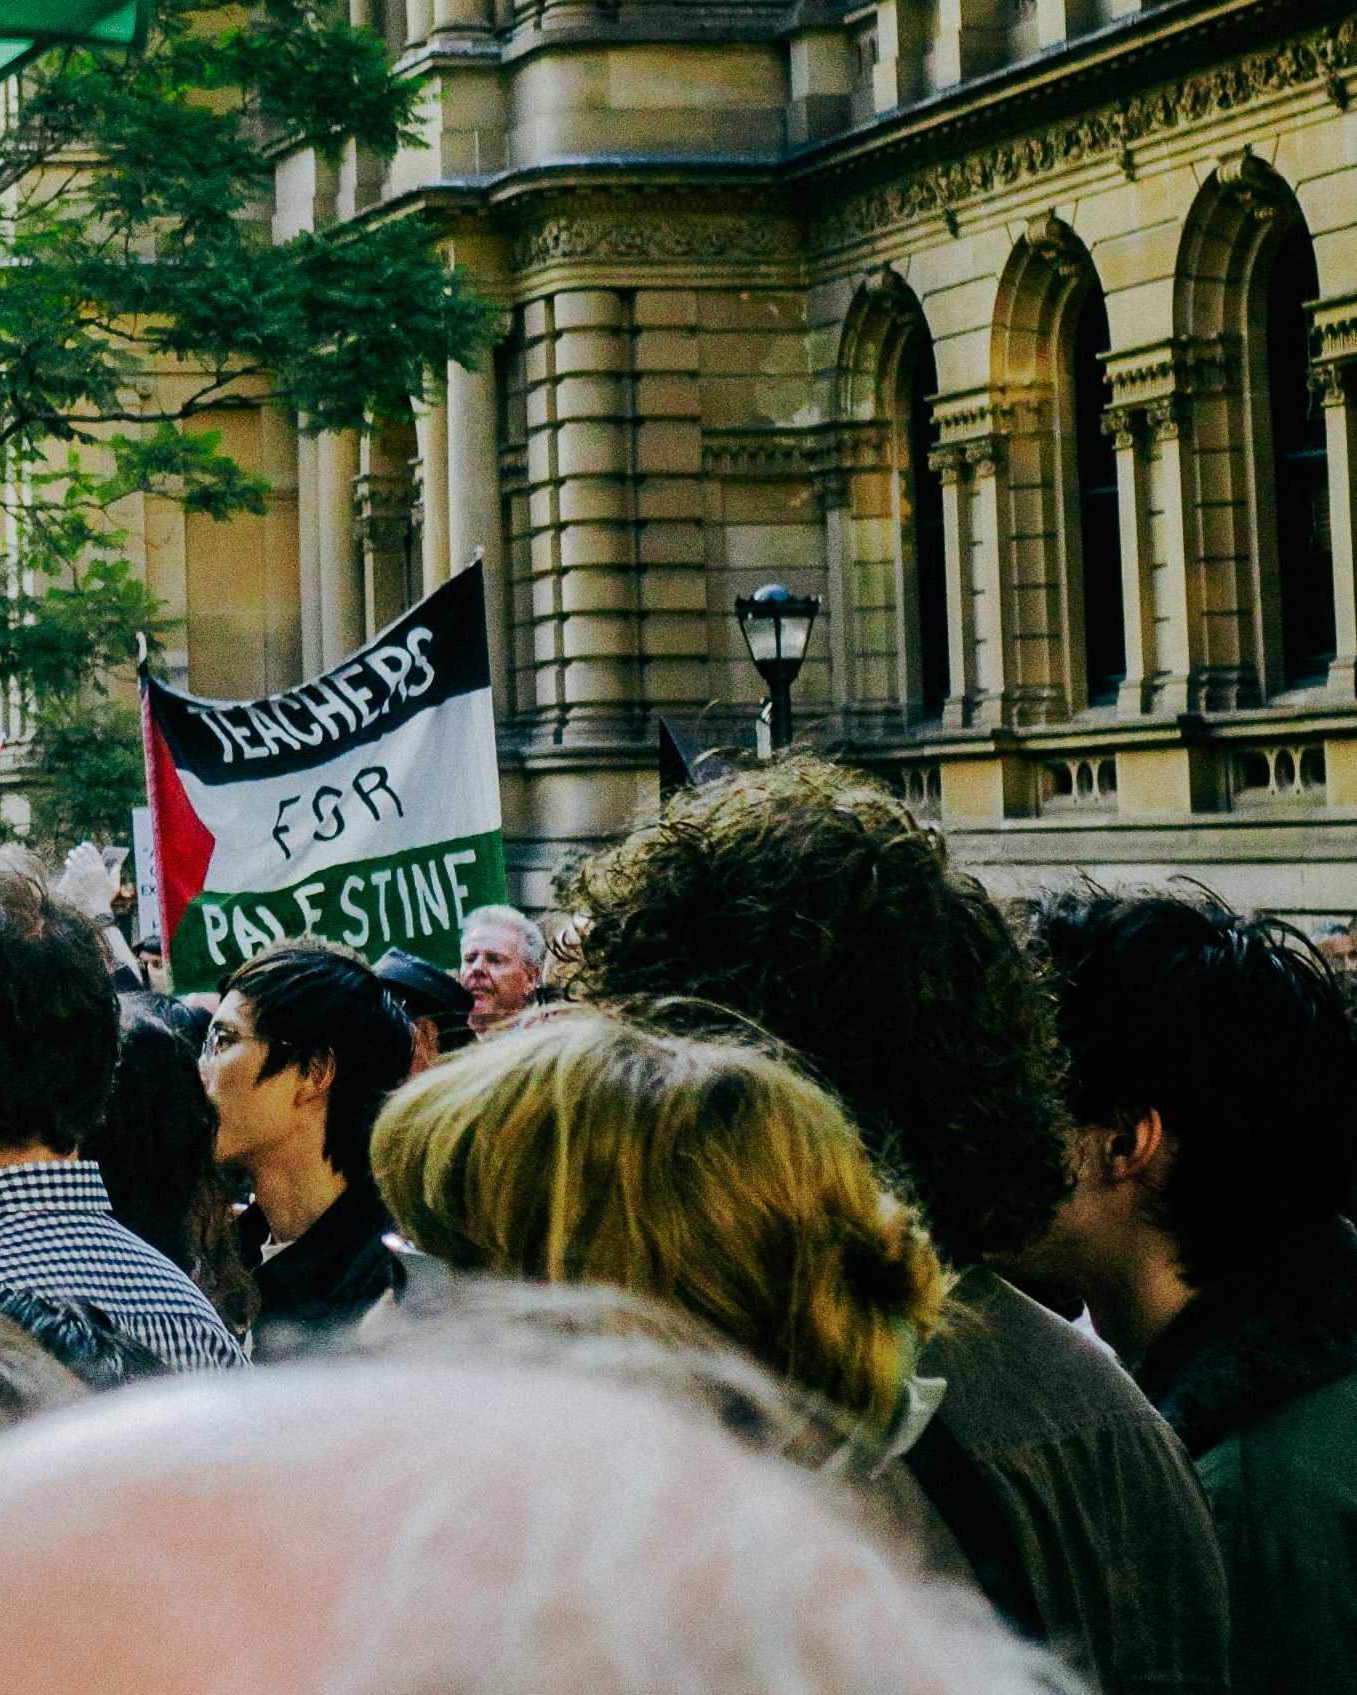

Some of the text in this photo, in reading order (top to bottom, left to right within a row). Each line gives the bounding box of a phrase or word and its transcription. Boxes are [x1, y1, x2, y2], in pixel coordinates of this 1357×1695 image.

[187, 626, 435, 763] TEACHERS
[273, 766, 404, 860] FOR
[201, 849, 476, 966] PALESTINE
